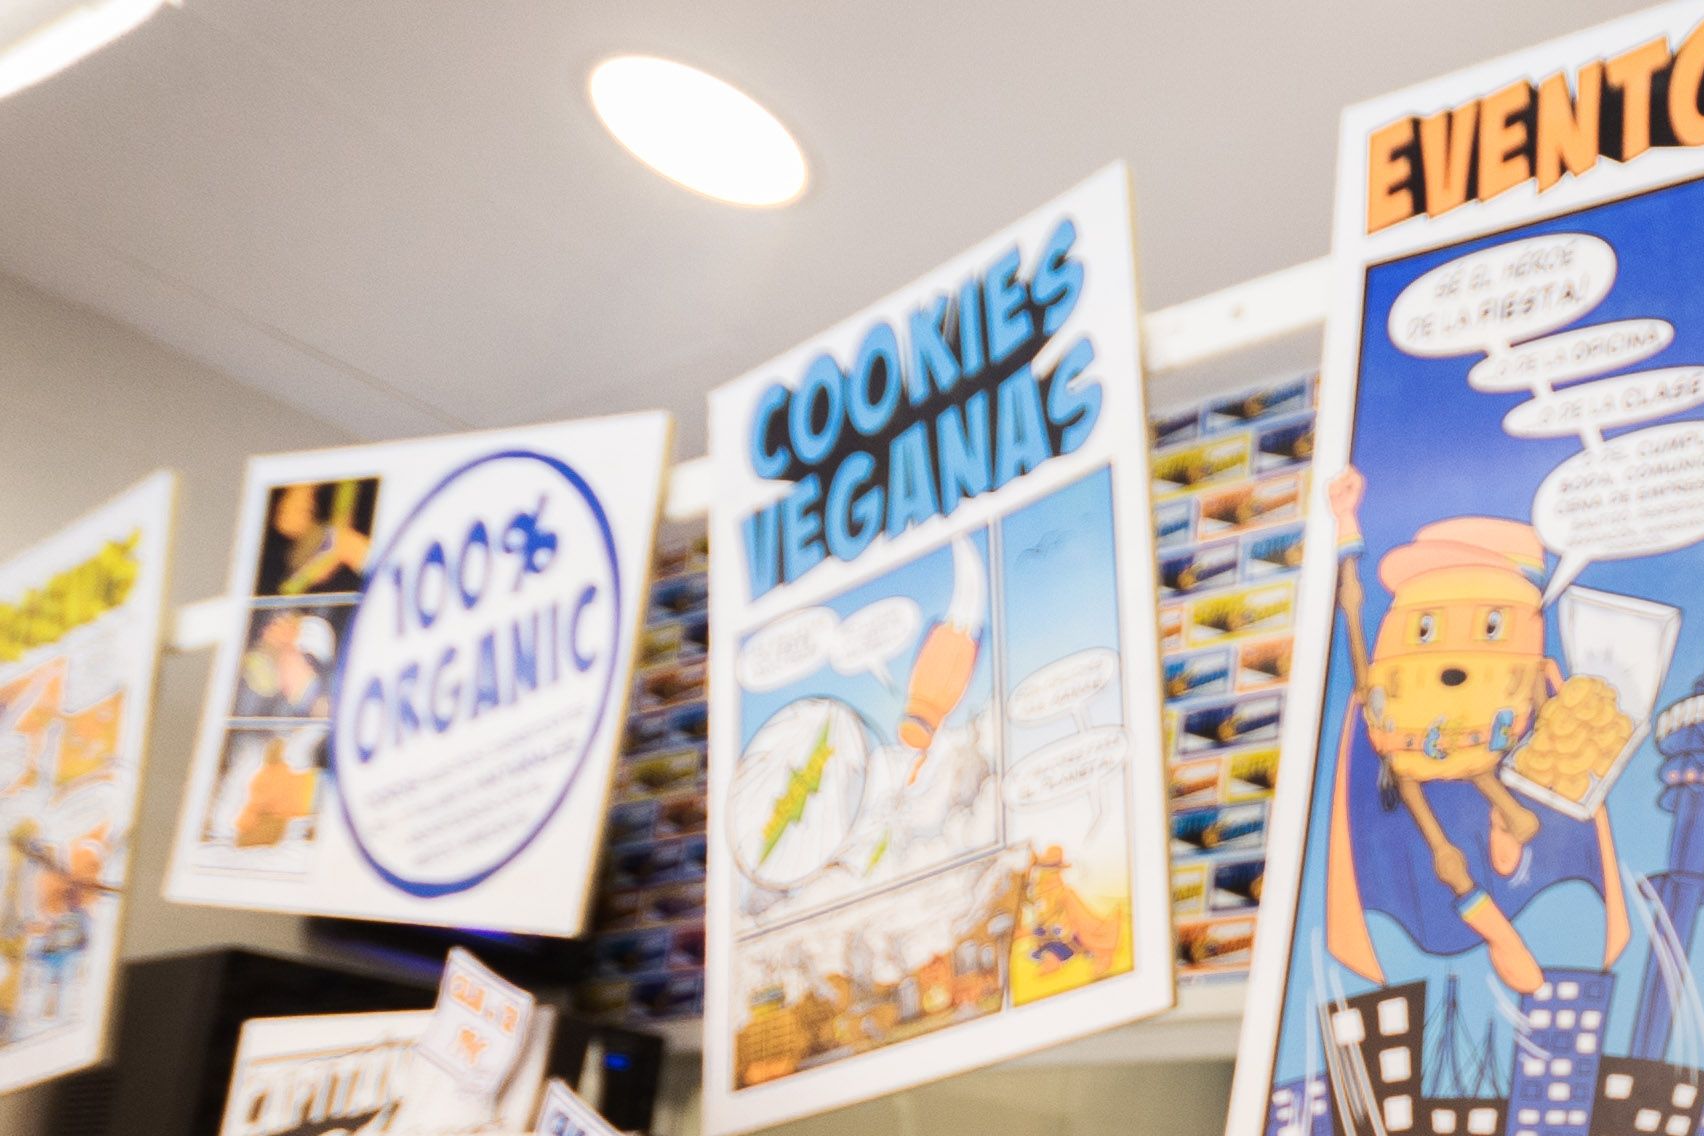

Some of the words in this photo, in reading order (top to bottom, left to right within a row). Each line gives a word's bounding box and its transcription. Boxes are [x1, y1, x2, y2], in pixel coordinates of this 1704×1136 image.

[750, 217, 1084, 480] COOKIES
[390, 492, 559, 639] 100%
[740, 323, 1102, 603] VEGANAS
[352, 584, 598, 765] ORGANIC
